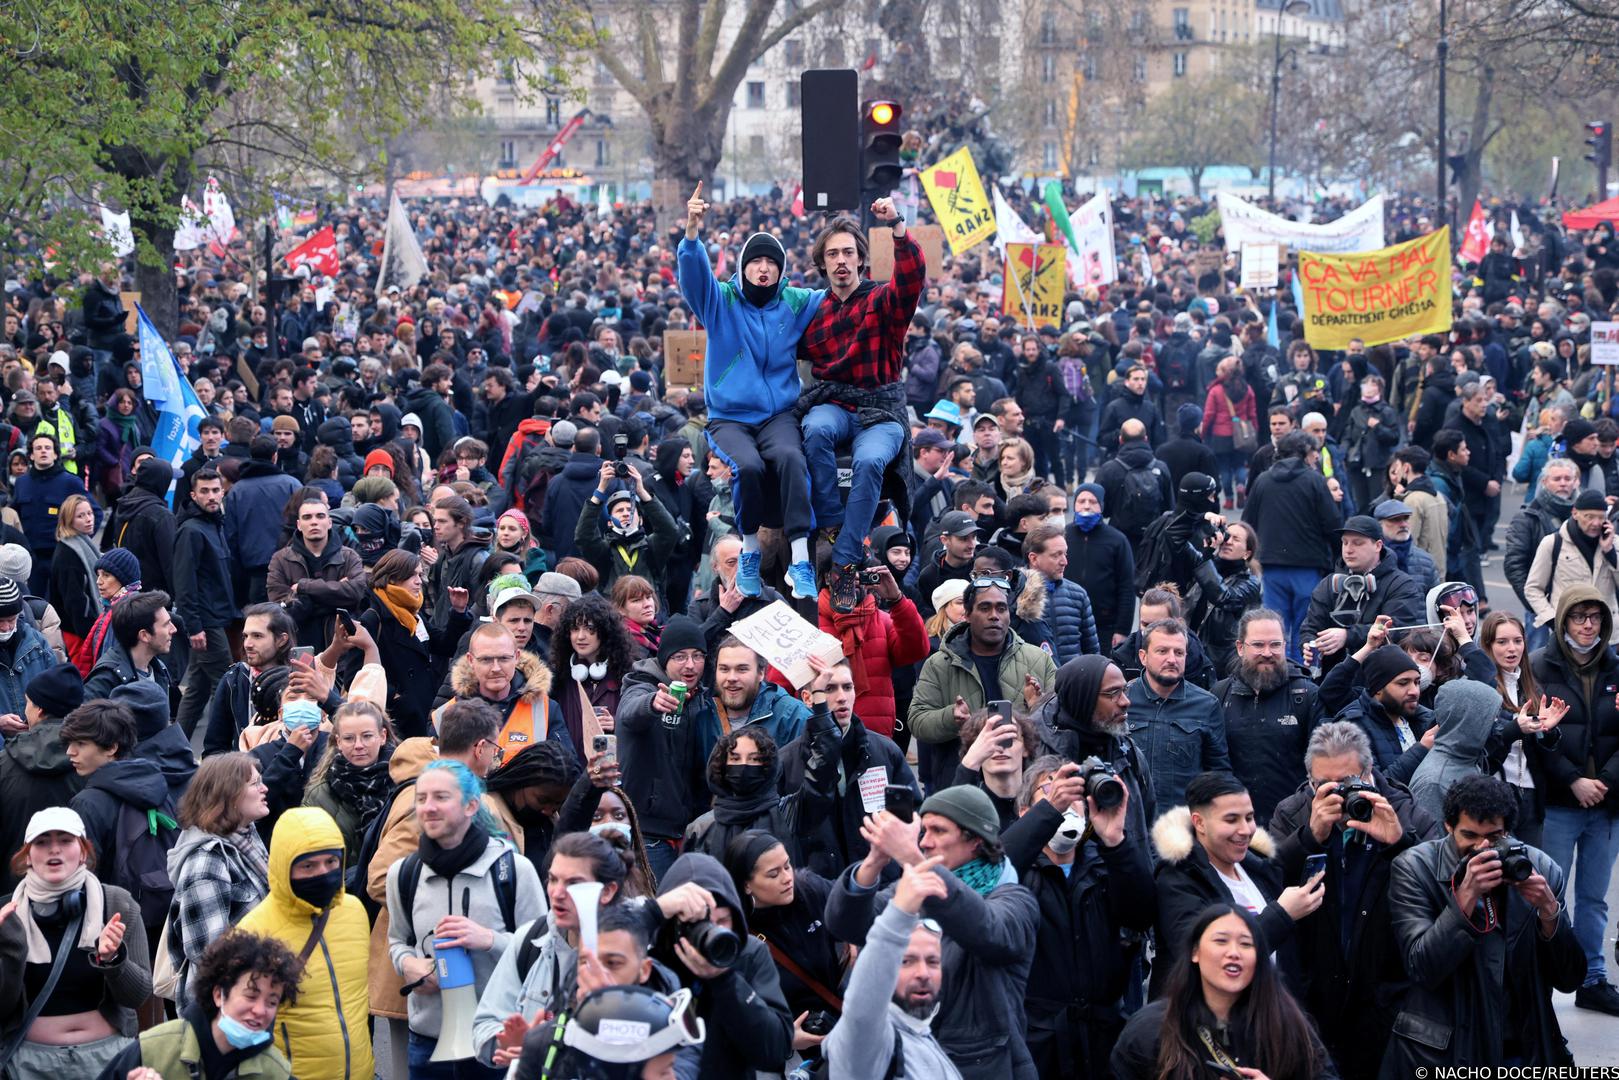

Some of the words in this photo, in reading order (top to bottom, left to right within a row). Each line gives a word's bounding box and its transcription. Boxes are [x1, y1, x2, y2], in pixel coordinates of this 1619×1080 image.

[1346, 260, 1381, 282] VA
[1389, 244, 1436, 275] MAL
[1309, 269, 1438, 314] TOURNER
[1311, 312, 1385, 326] DÉPARTEMENT
[1389, 299, 1437, 320] CINÉMA
[602, 1023, 647, 1037] PHOTO
